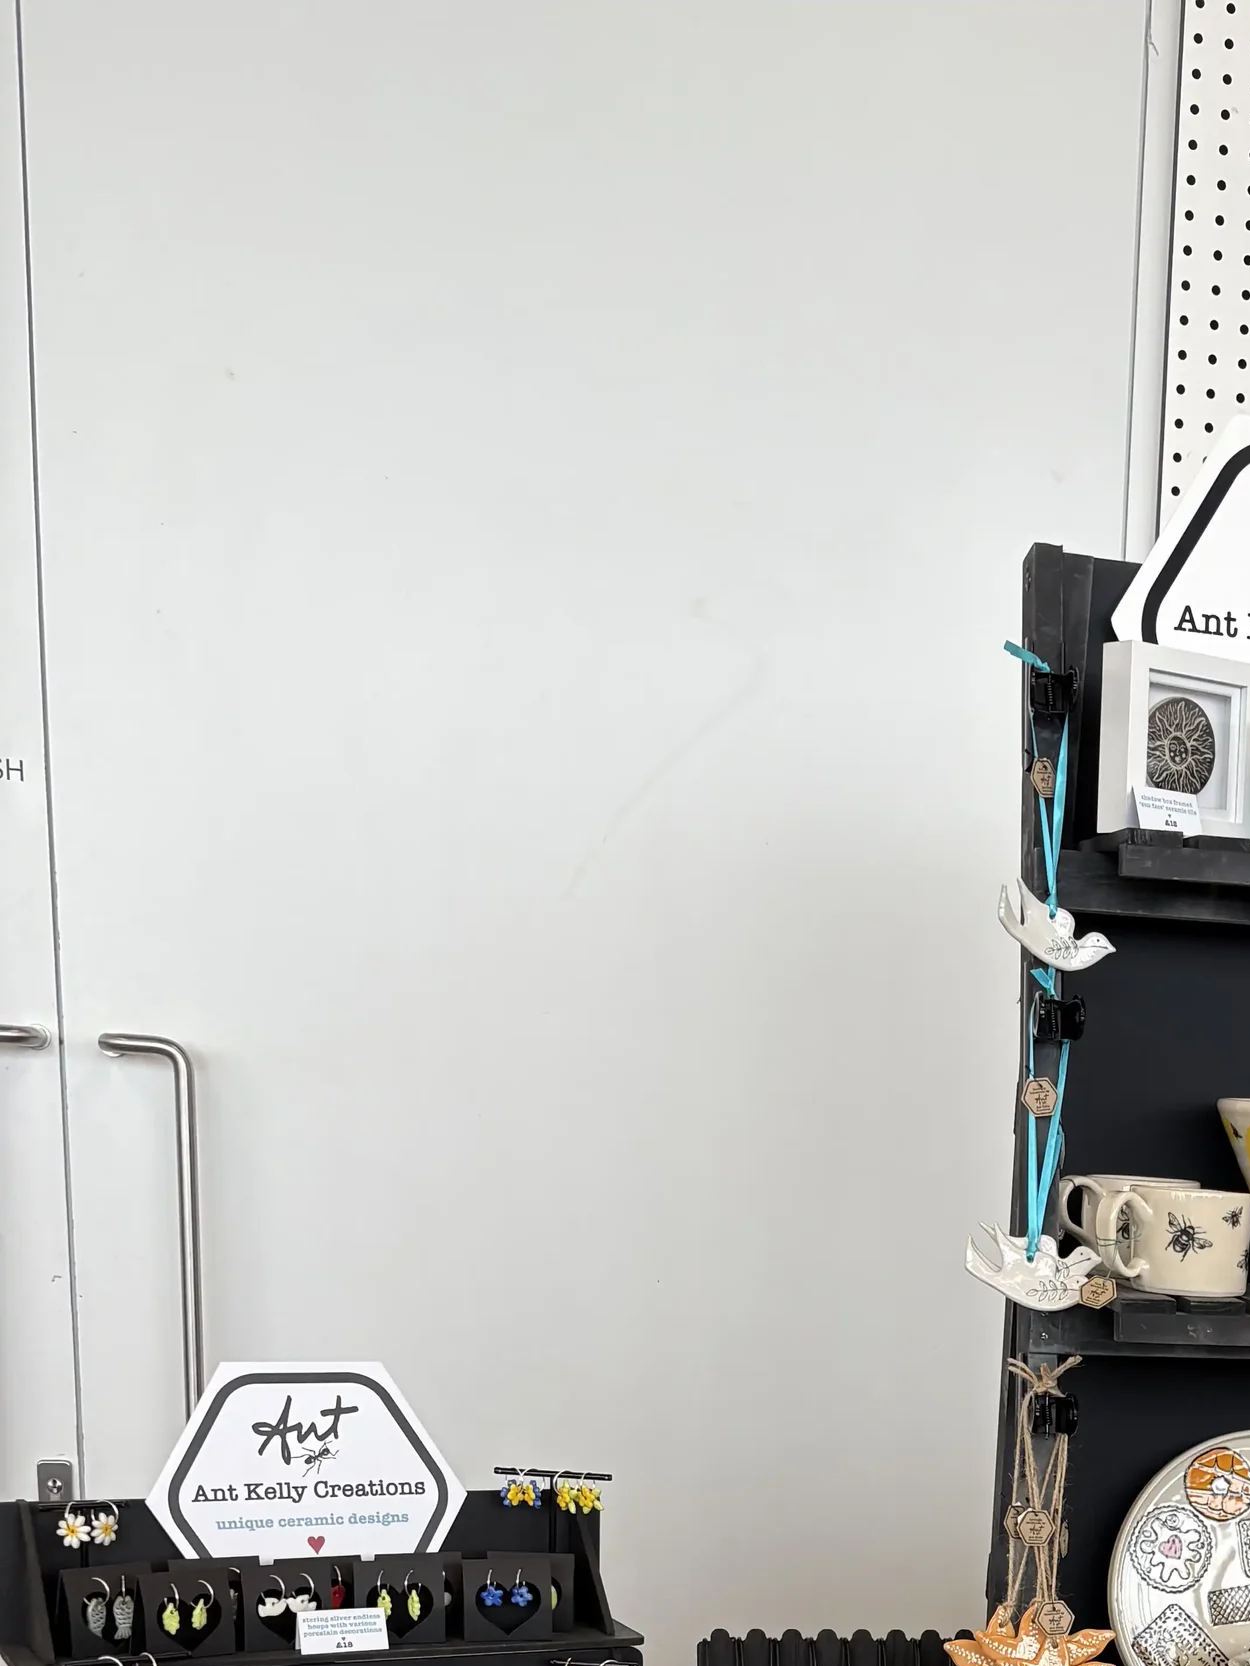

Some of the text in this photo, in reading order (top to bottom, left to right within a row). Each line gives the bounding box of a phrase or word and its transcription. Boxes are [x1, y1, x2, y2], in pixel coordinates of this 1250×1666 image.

[1174, 605, 1238, 638] Ant
[252, 1395, 359, 1465] Ant
[192, 1479, 425, 1503] Ant Kelly Creations
[216, 1511, 408, 1531] unique ceramic designs
[304, 1627, 382, 1638] porcelain decorations
